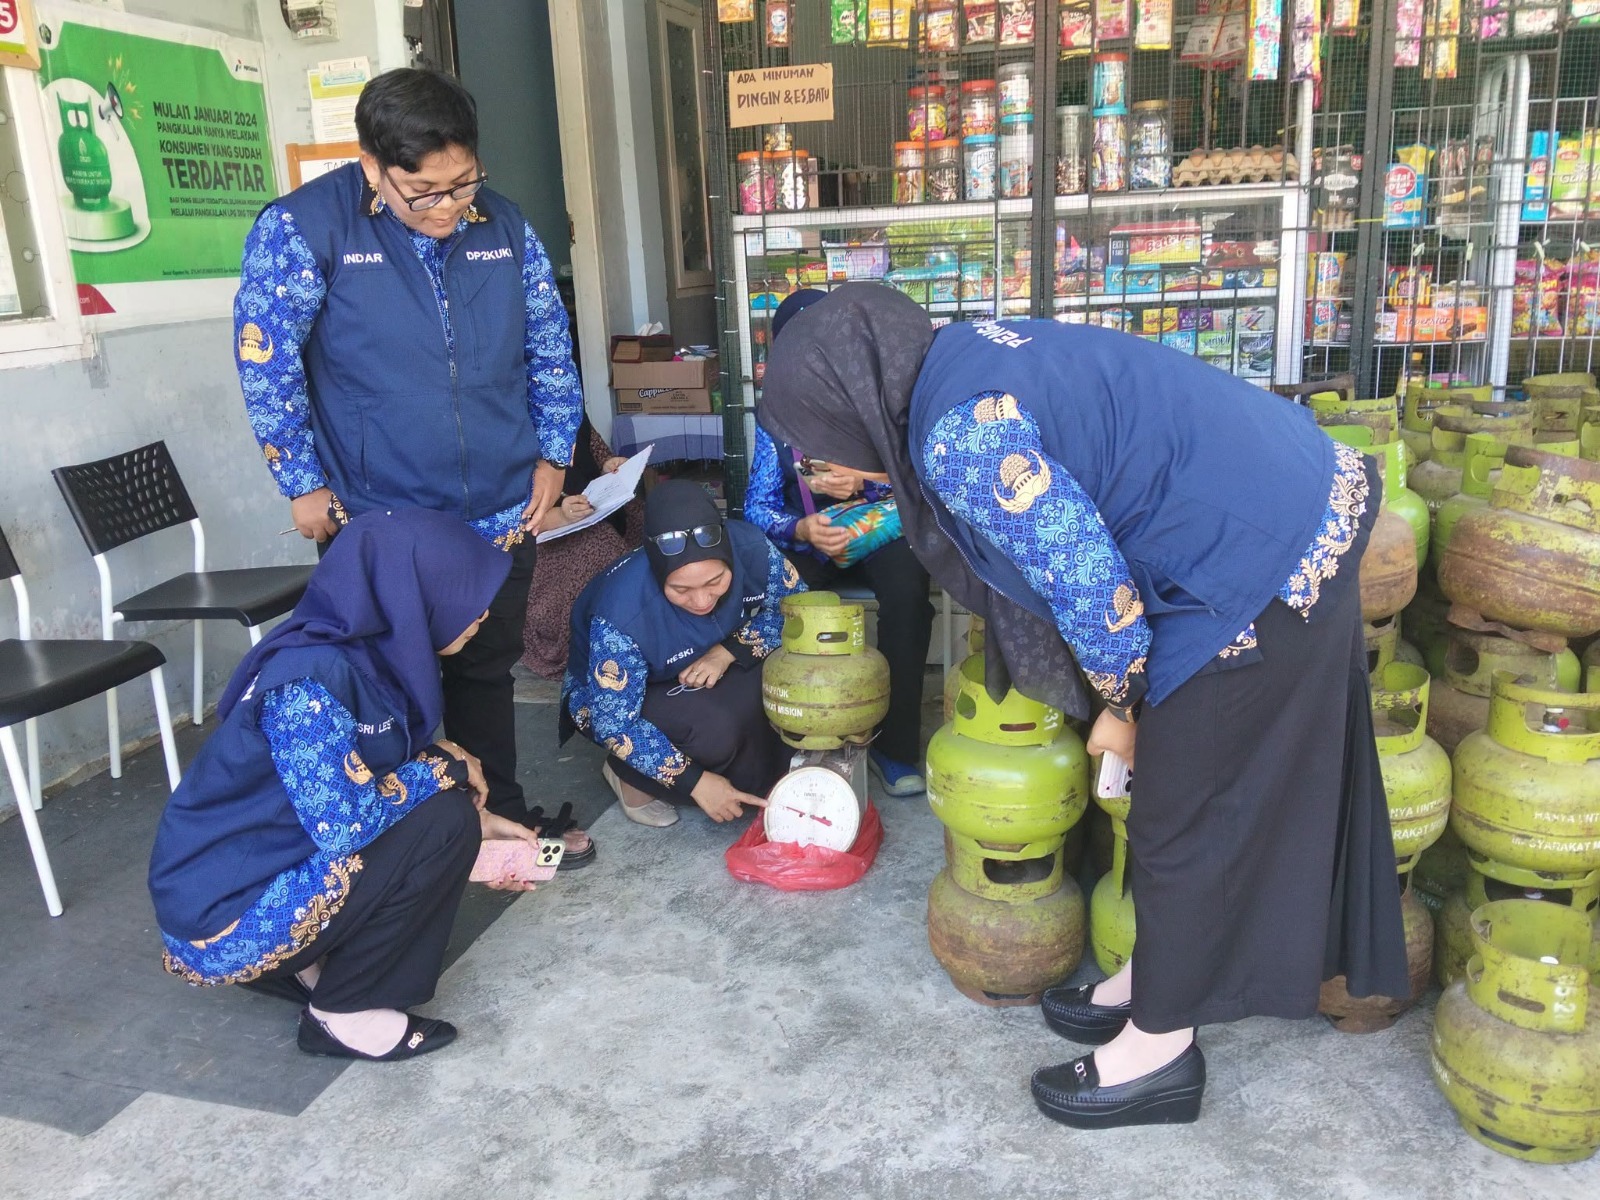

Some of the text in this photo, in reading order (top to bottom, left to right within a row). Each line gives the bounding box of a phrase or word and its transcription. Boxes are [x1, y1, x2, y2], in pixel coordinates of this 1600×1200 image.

[737, 68, 814, 84] ADA MINUMAN
[737, 90, 780, 108] DINGIN
[194, 105, 232, 125] JANUARI
[234, 111, 257, 127] 2024
[157, 121, 260, 141] PANGKALAN HANYA MELAYANI
[160, 140, 262, 160] KONSUMEN YANG SUDAH
[162, 157, 266, 192] TERDAFTAR
[343, 253, 383, 264] INDAR
[777, 705, 803, 717] MISKIN
[358, 723, 374, 735] SRI
[1534, 812, 1575, 823] HANYA
